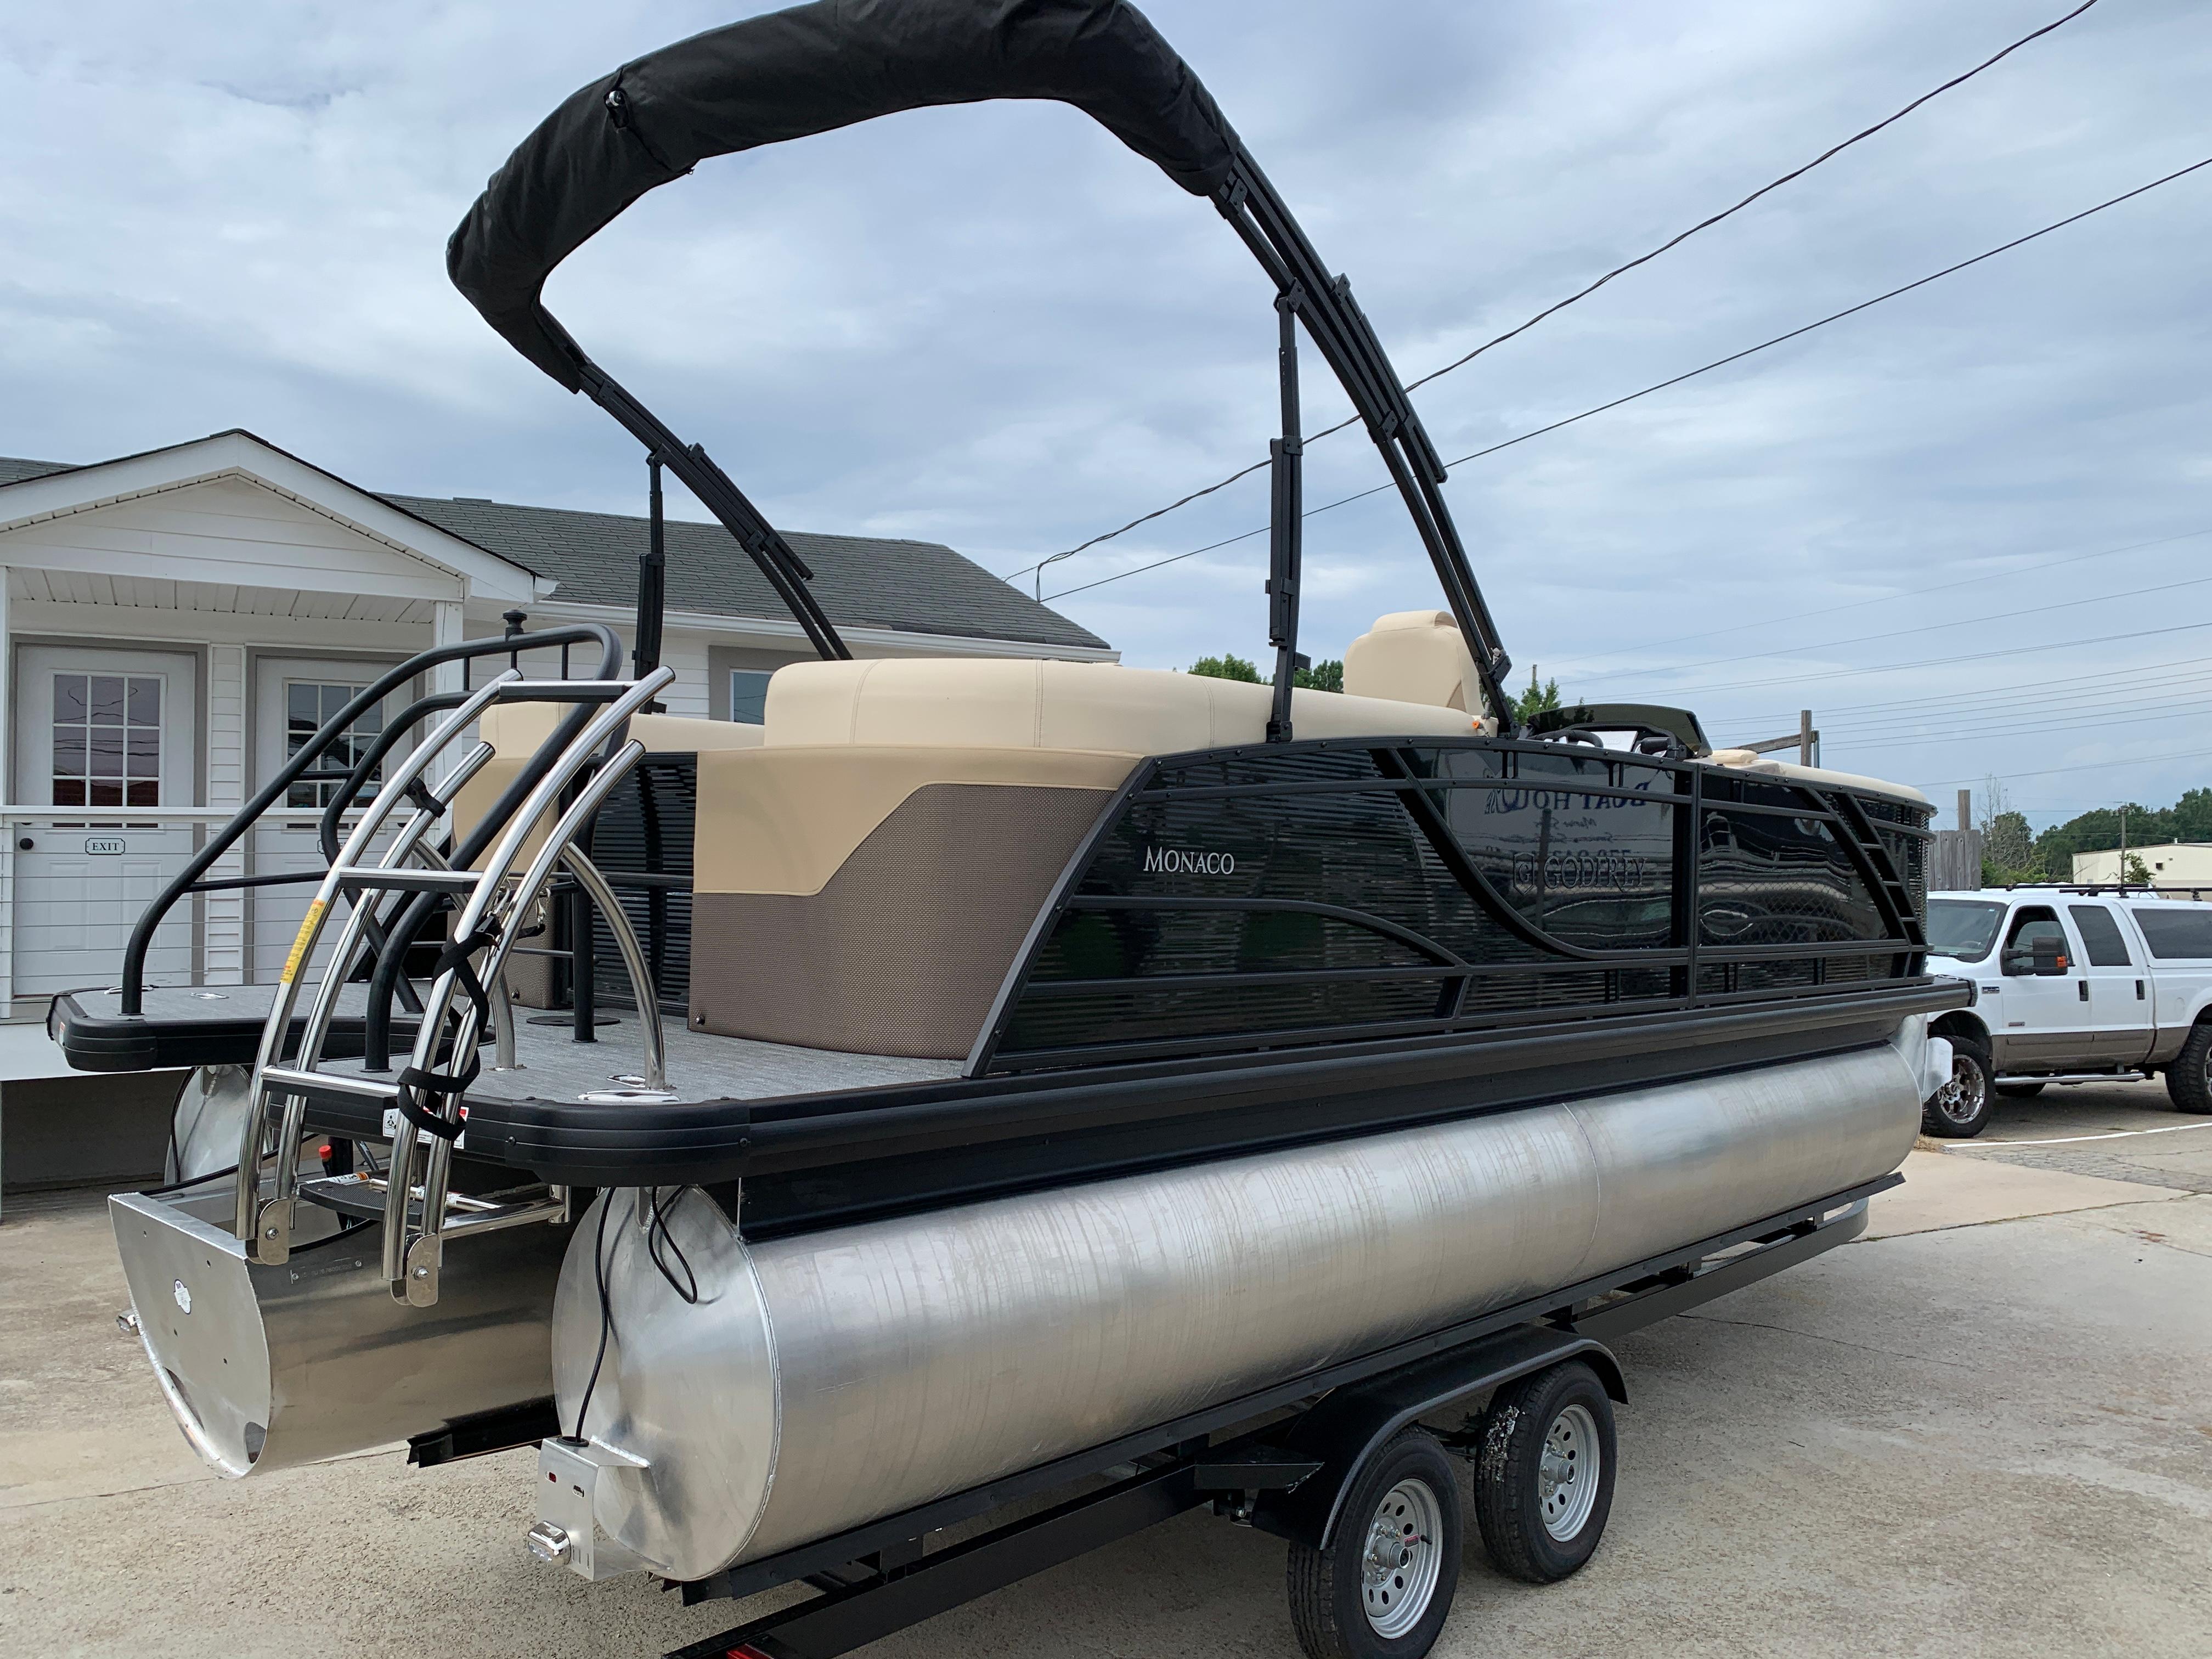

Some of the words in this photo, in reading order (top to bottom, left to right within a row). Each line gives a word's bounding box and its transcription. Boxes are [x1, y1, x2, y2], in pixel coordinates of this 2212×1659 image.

[92, 842, 120, 851] EXIT
[1143, 845, 1234, 874] MONACO
[1544, 855, 1647, 893] GODFREY
